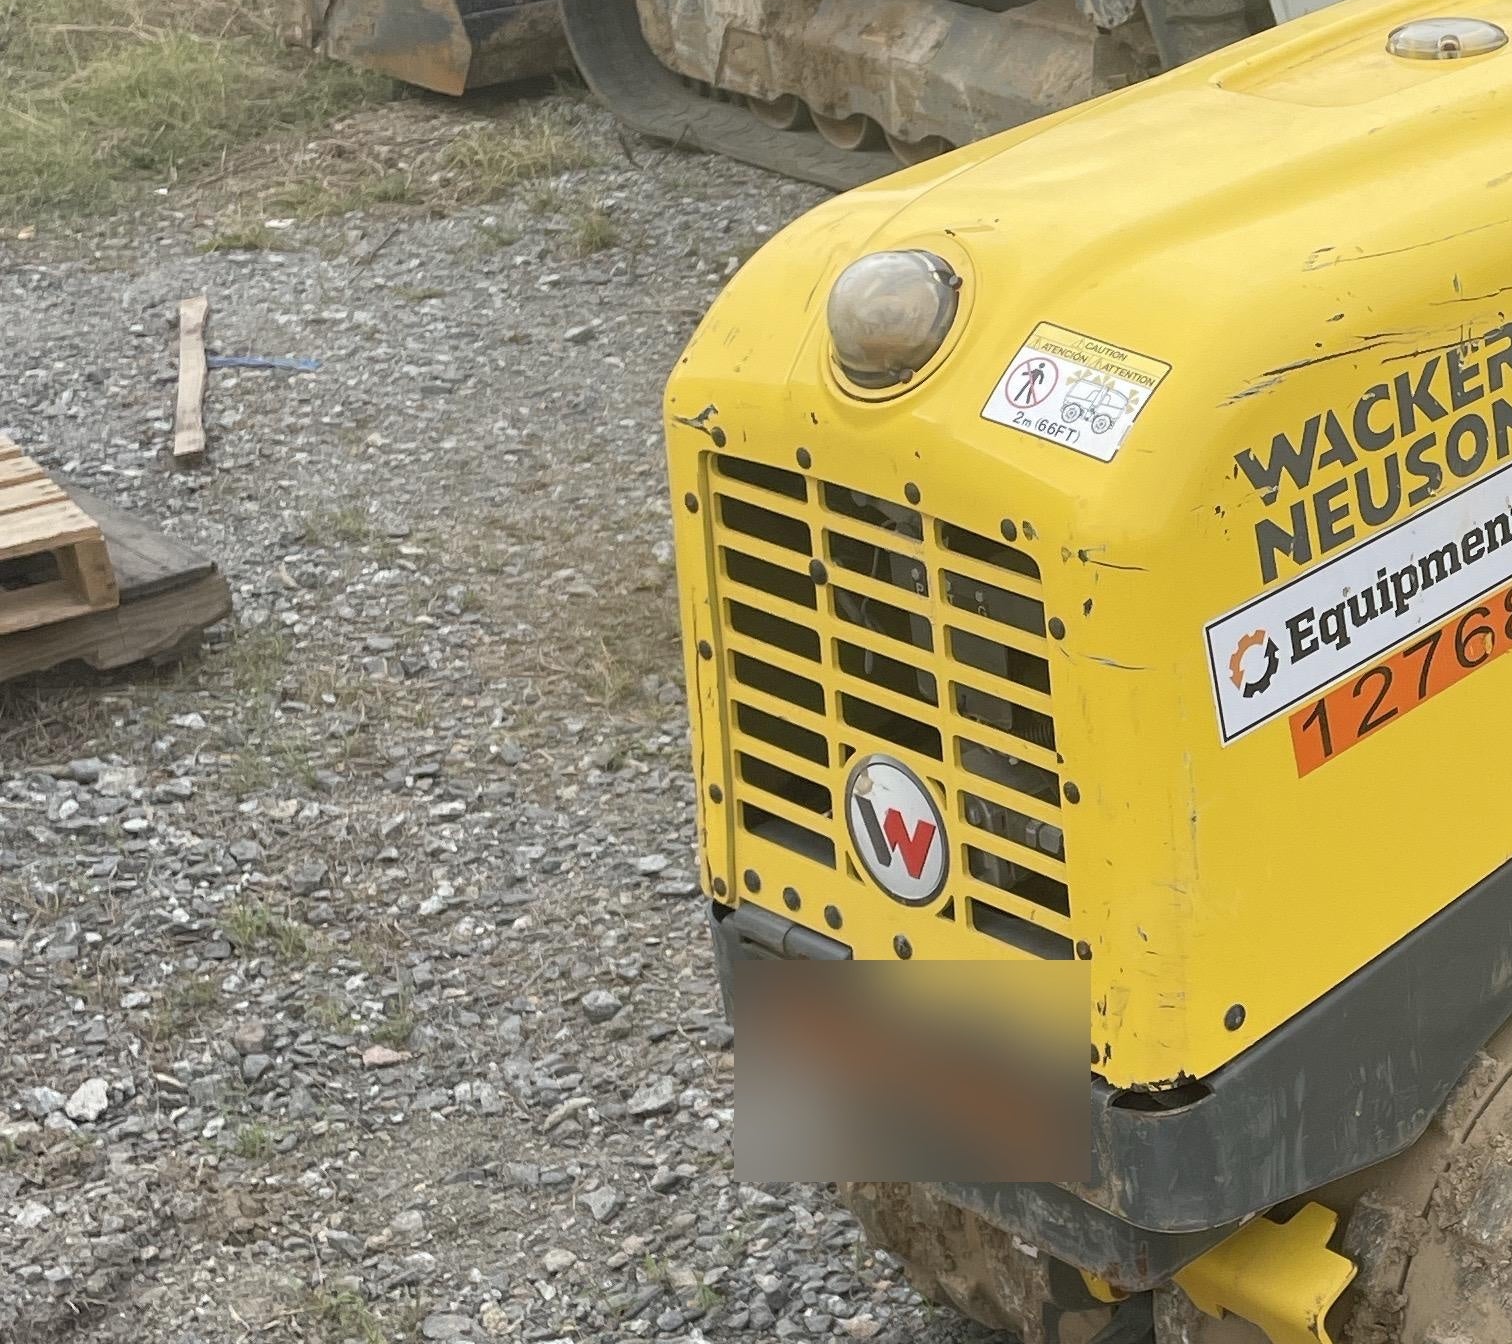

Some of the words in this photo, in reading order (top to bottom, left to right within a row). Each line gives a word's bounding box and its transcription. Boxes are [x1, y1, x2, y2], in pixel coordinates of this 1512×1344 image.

[1042, 342, 1089, 363] ATENCIÓN
[1085, 341, 1128, 362] CAUTION
[1102, 364, 1156, 387] ATTENTION
